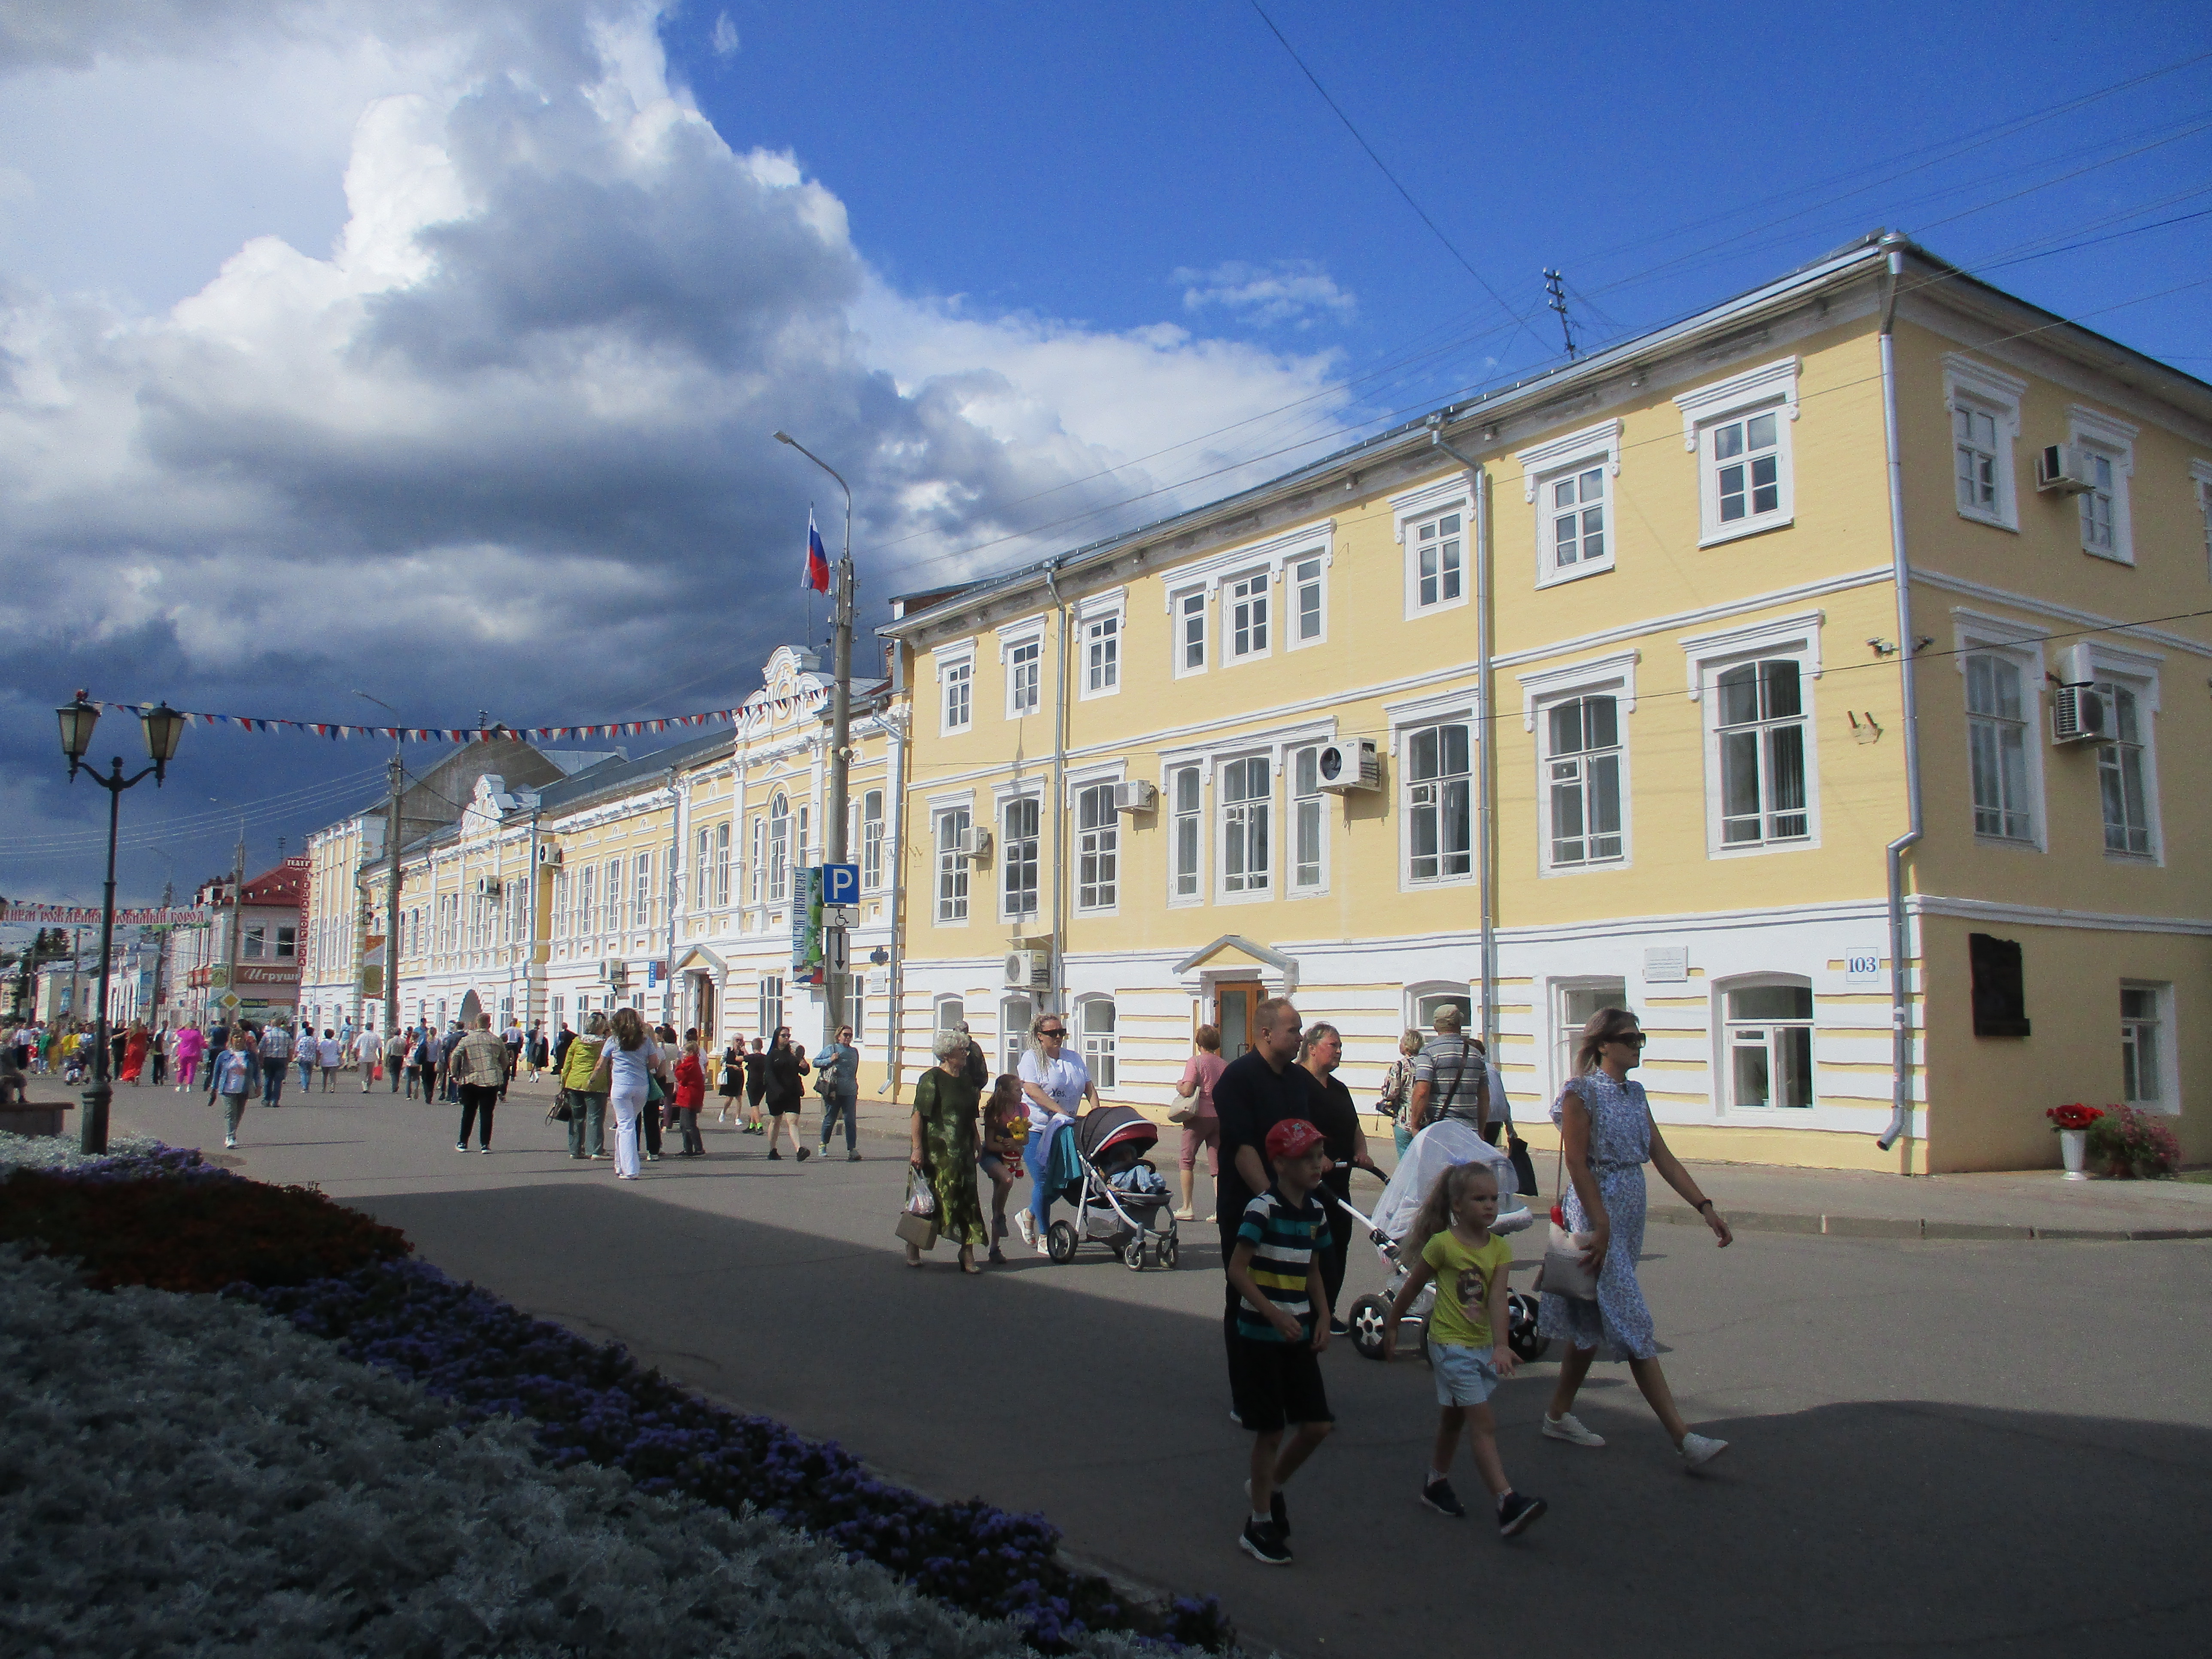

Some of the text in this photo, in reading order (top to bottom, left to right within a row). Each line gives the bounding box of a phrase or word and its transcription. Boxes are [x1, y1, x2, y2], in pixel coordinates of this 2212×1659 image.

[833, 869, 853, 899] P
[115, 910, 166, 924] ЮБИМЫЙ
[171, 911, 204, 923] ГОРОД
[793, 872, 807, 954] ВЕЛИКИЙ УСТЮГ
[1848, 957, 1875, 972] 103
[1052, 1088, 1066, 1098] Yes,
